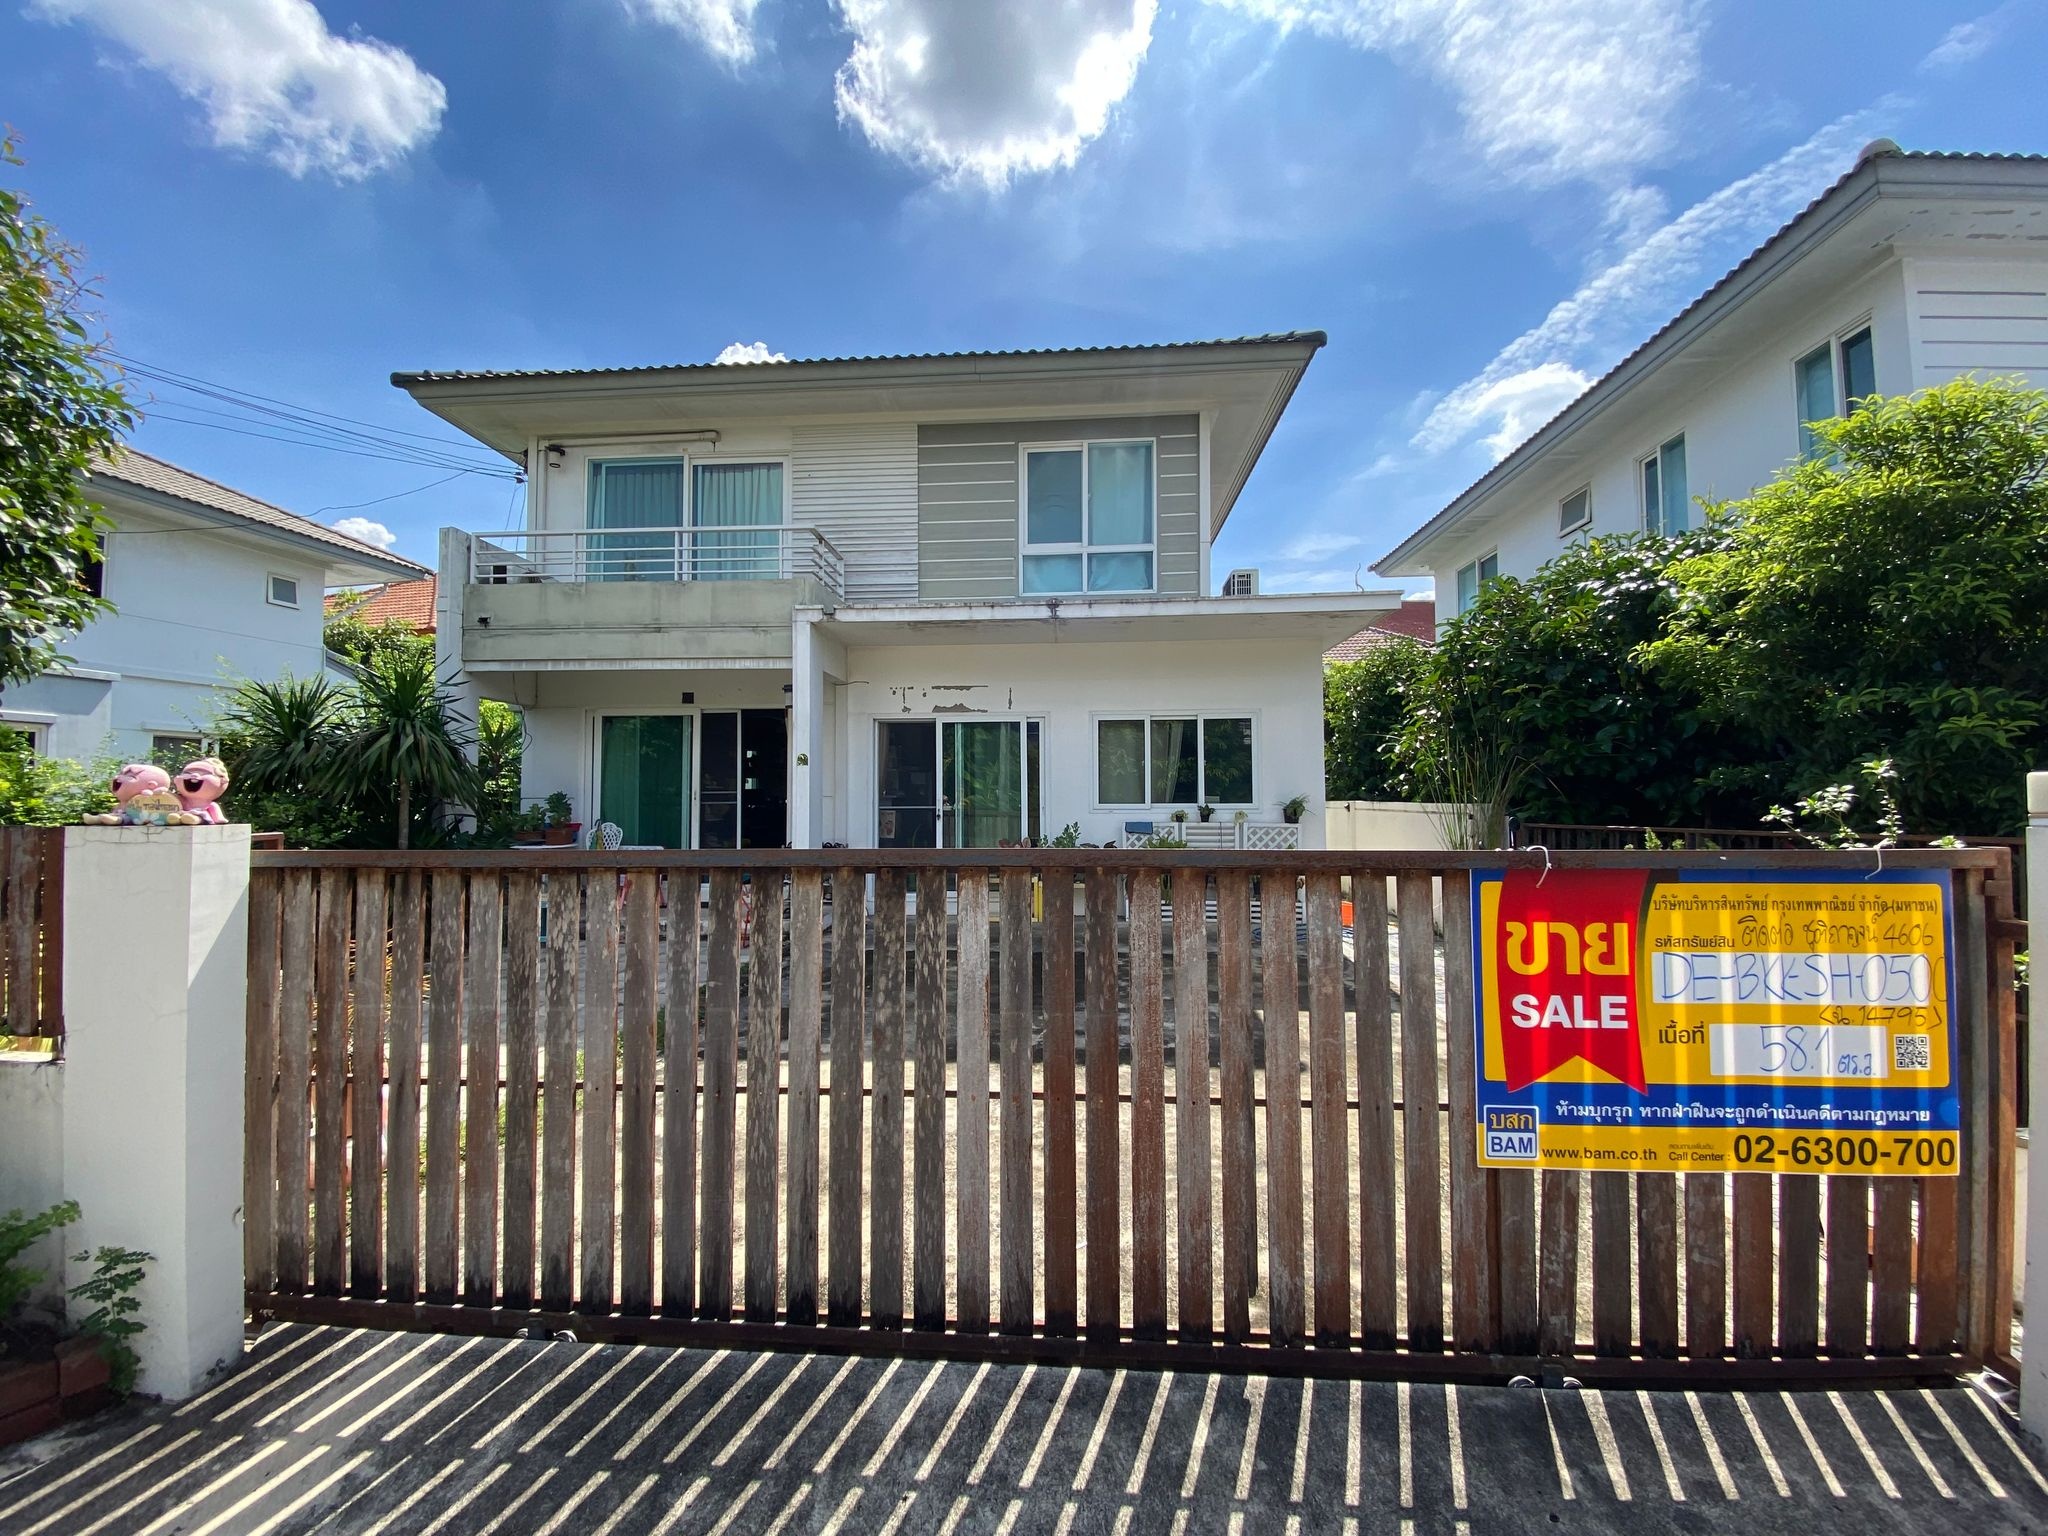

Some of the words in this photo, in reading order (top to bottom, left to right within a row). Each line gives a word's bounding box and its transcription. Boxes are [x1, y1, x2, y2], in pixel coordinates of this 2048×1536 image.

[1653, 894, 1769, 911] บริษัทบริหารสินทรัพย์
[1771, 894, 1856, 915] กรุงเทพพาณิชย์
[1890, 899, 1938, 914] (มหาชน)
[1654, 934, 1736, 949] รหัสทรัพย์สิน
[1883, 922, 1935, 950] 4606
[1505, 921, 1630, 977] ขาย
[1510, 993, 1630, 1030] SALE
[1658, 1019, 1705, 1044] เนื้อที่
[1759, 1025, 1831, 1075] 58.1
[1489, 1112, 1533, 1130] บสก
[1555, 1100, 1633, 1123] ห้ามบุกรุก
[1638, 1102, 1931, 1126] หากฝ่าฝืนจะถูกดำเนินคดีตามกฎหมาย
[1490, 1135, 1533, 1154] BAM
[1542, 1146, 1658, 1162] www.bam.co.th
[1668, 1151, 1688, 1161] Call
[1690, 1151, 1725, 1162] Center
[1733, 1134, 1956, 1167] 02-6300-700
